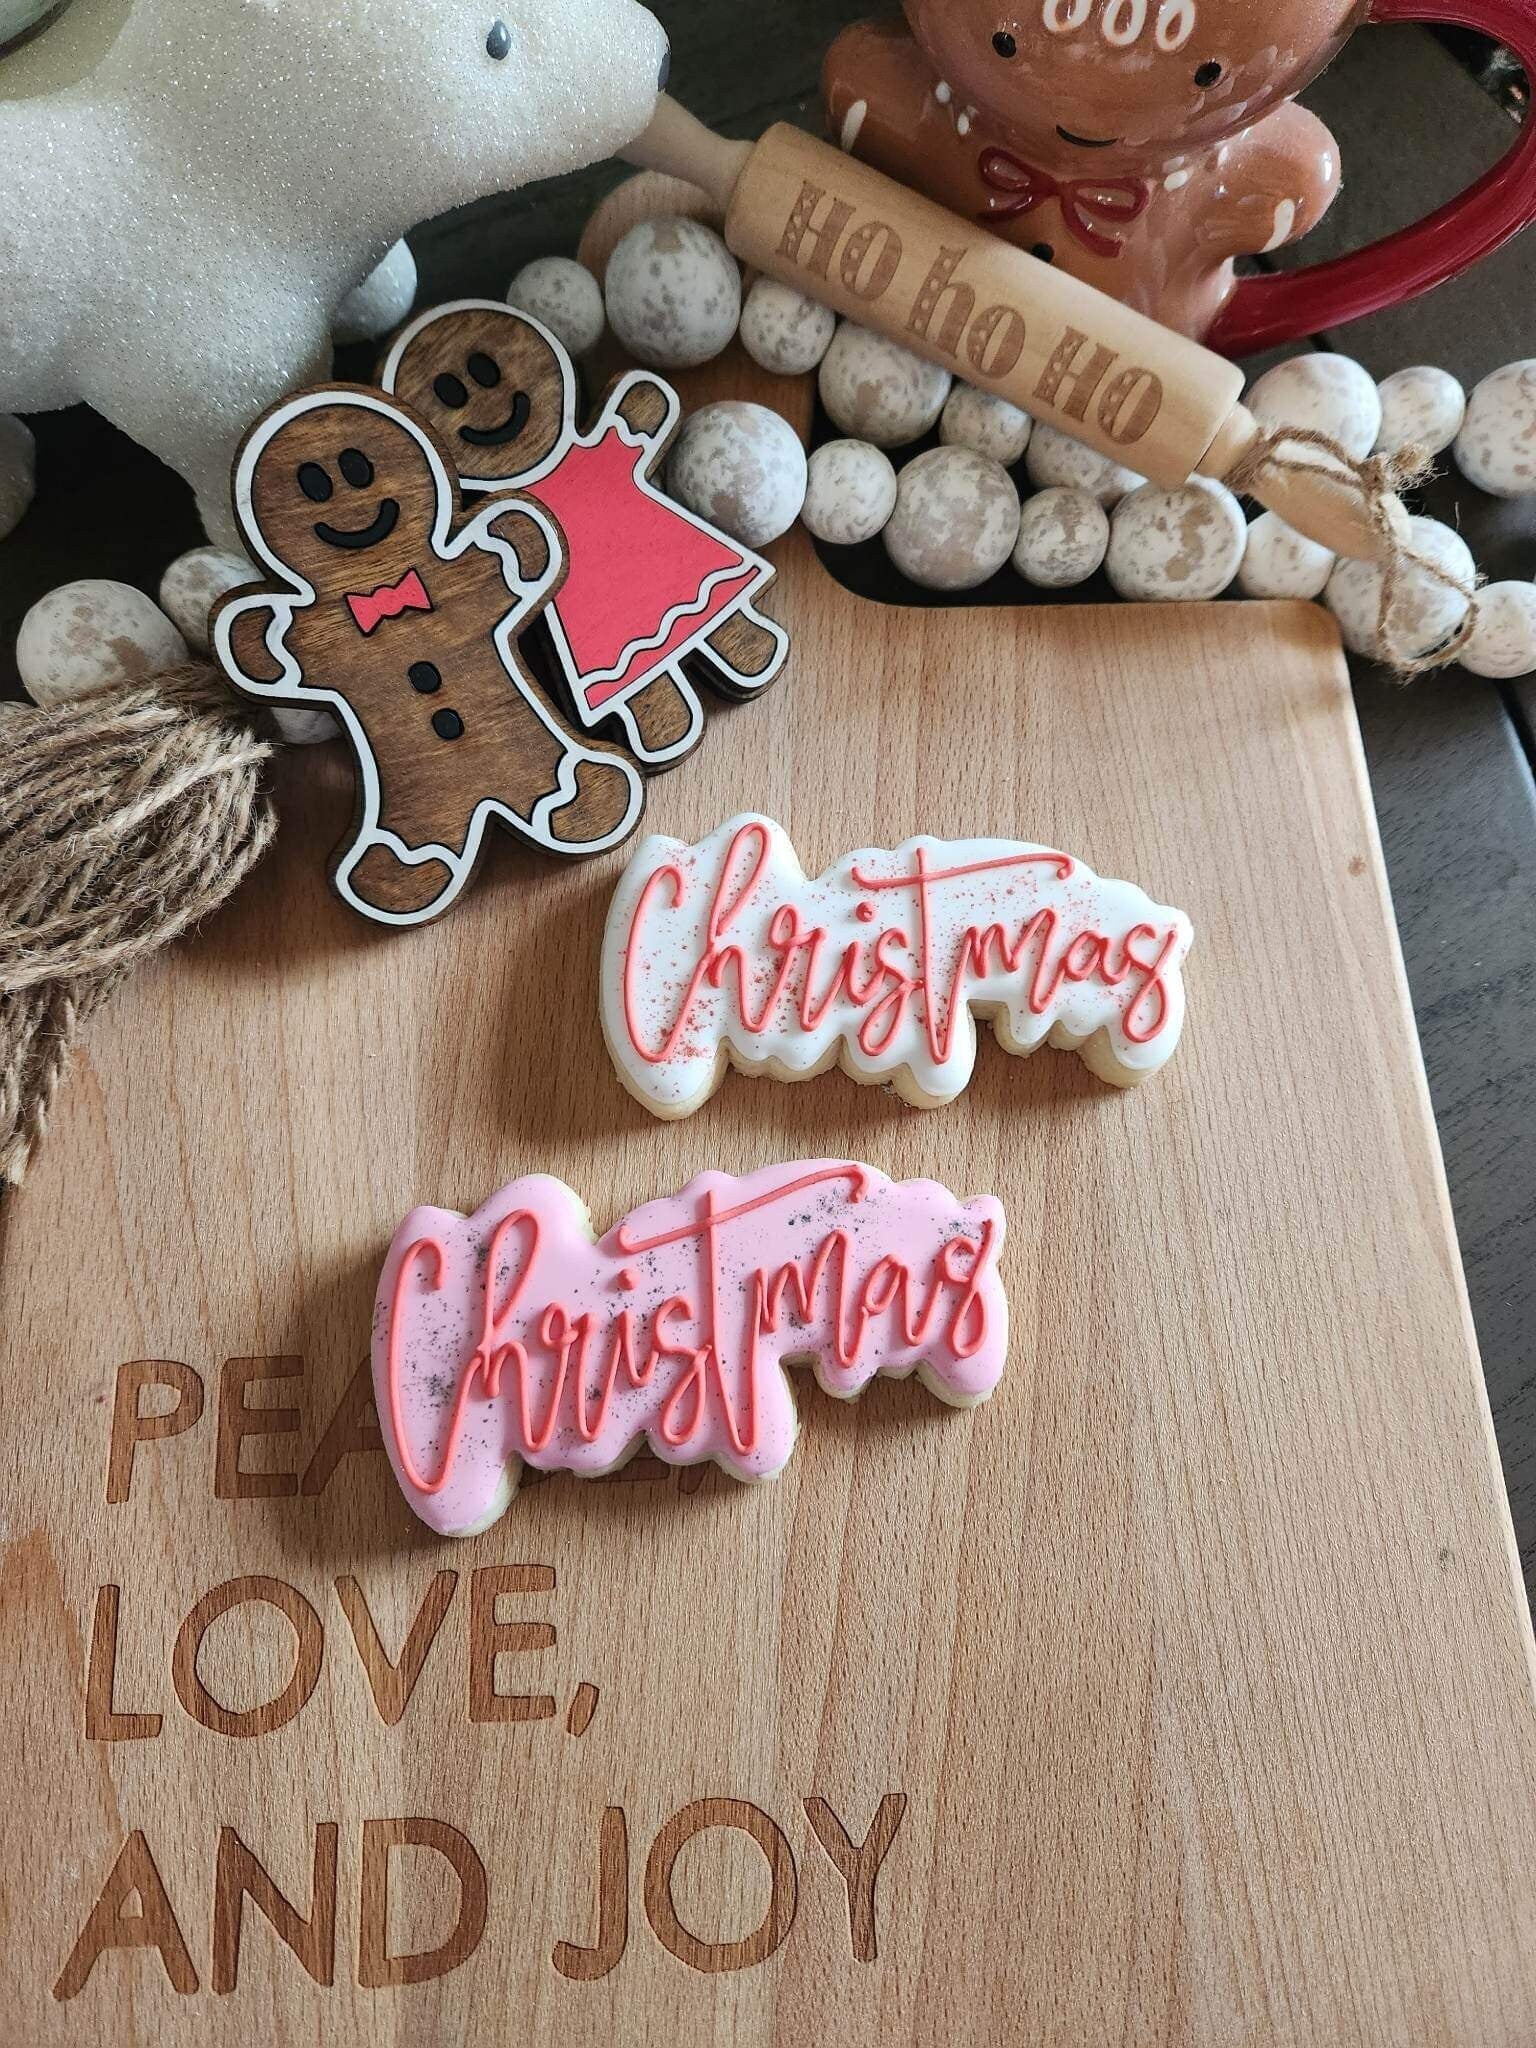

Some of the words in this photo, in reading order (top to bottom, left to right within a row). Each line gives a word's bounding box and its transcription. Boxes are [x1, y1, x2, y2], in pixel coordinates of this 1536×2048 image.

[623, 822, 1178, 1065] Christmas
[388, 1164, 995, 1495] Christmas
[85, 1563, 601, 1742] LOVE,
[52, 1816, 488, 2001] AND
[551, 1792, 908, 1982] JOY
